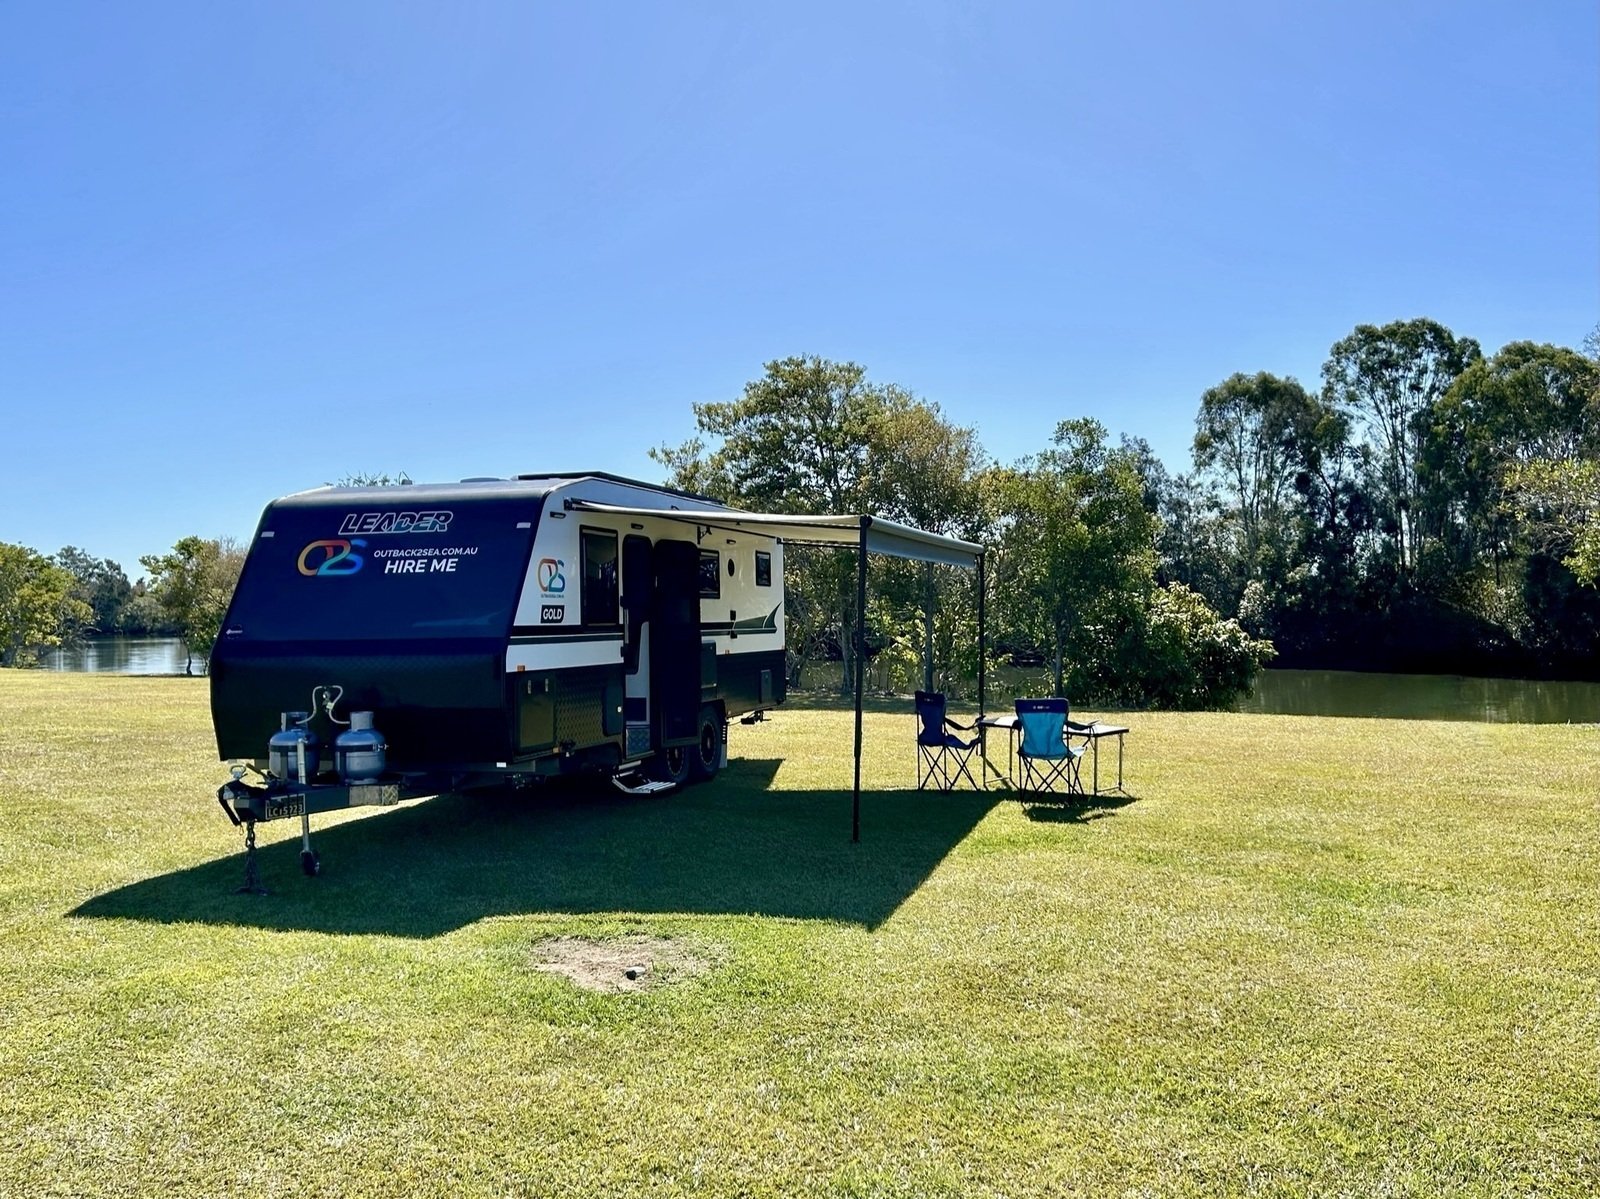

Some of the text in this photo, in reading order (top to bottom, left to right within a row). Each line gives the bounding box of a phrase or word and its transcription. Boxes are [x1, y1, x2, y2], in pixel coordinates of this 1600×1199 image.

[338, 511, 453, 535] LEADER
[373, 547, 478, 558] OUTBACK2SEA.COM.AU
[384, 558, 459, 574] HIRE ME
[542, 608, 563, 620] GOLD
